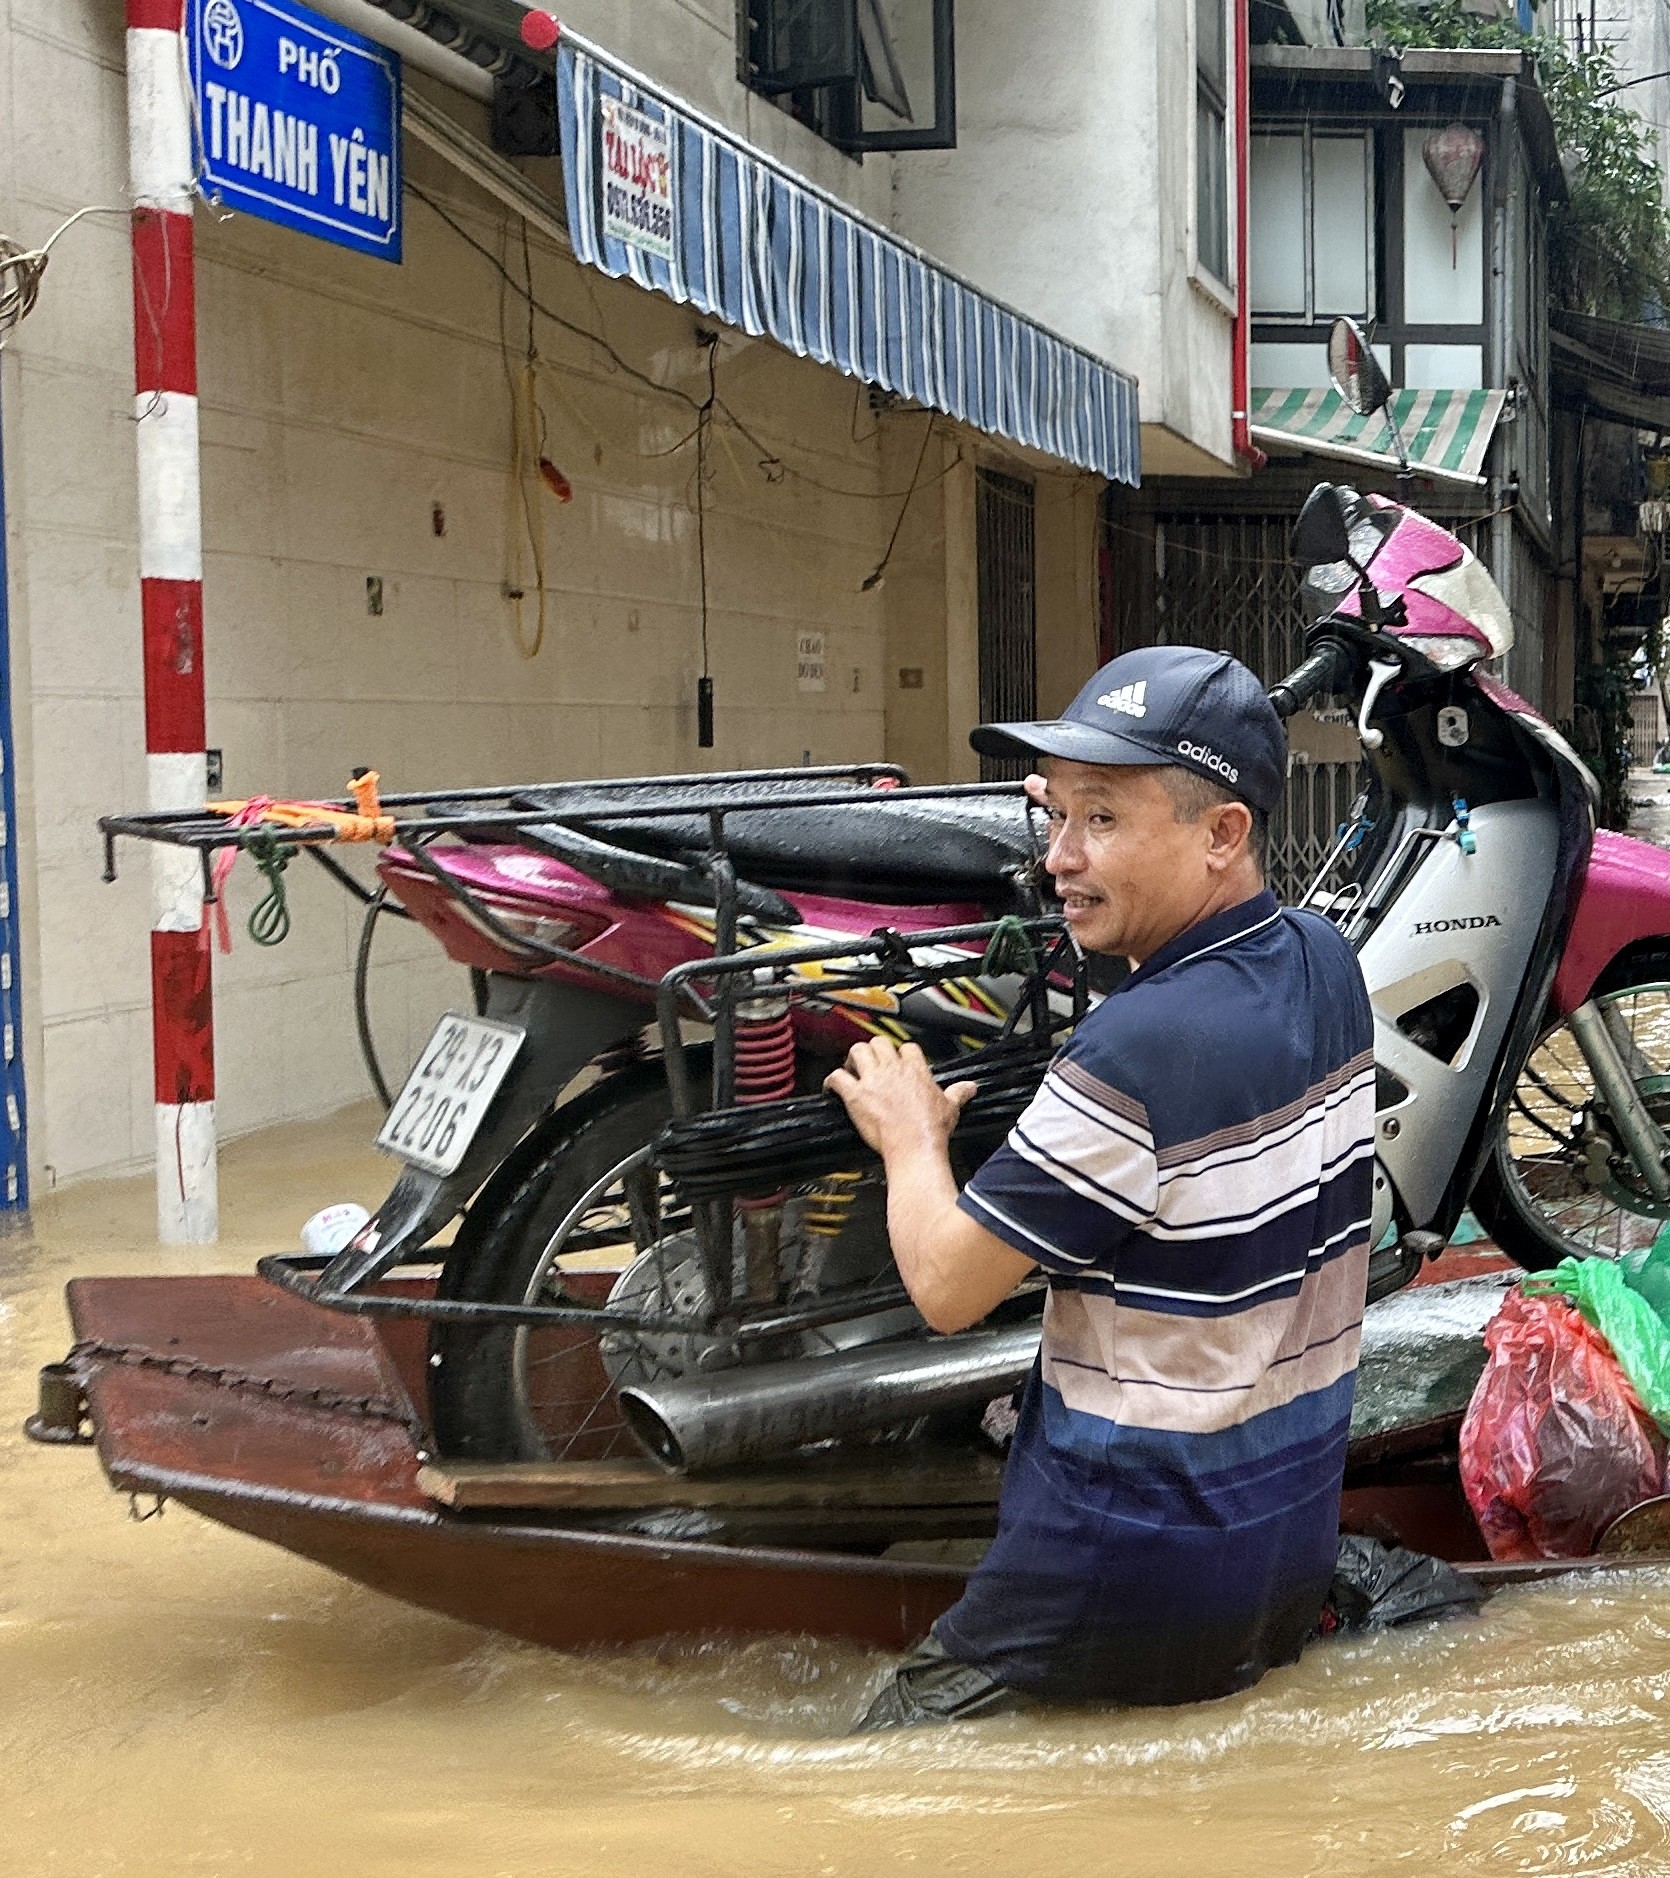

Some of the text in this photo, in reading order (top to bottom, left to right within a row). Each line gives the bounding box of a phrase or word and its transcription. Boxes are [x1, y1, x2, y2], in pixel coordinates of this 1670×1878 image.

[278, 36, 342, 95] PHỐ
[206, 80, 389, 223] THANH YÊN
[1177, 739, 1240, 784] adidas
[1414, 915, 1503, 935] HONDA
[421, 1022, 504, 1094] 29-X3
[389, 1085, 469, 1158] 2206
